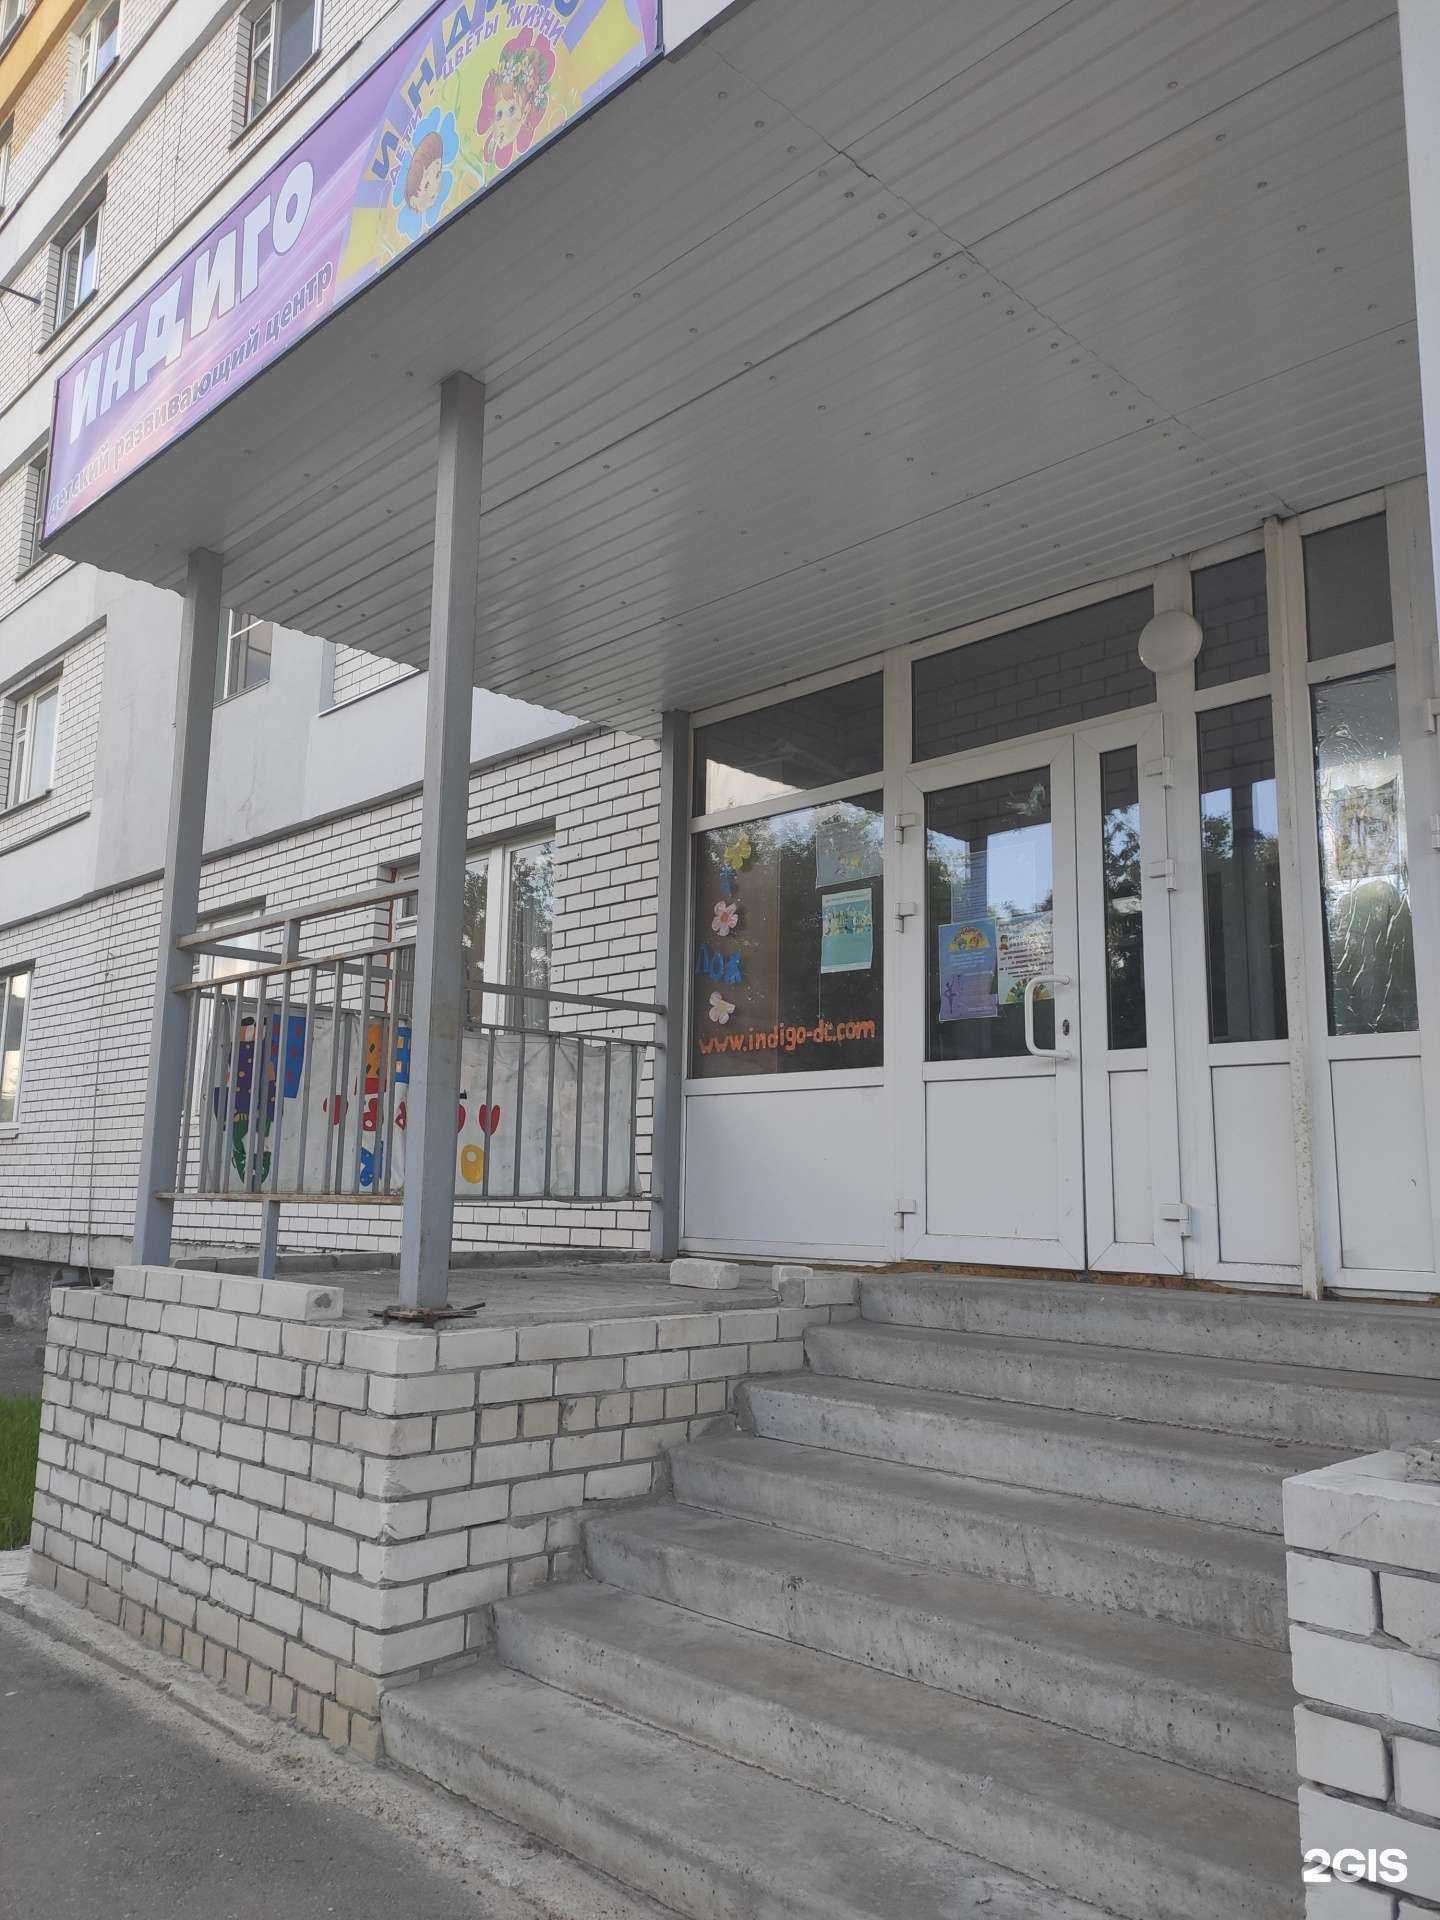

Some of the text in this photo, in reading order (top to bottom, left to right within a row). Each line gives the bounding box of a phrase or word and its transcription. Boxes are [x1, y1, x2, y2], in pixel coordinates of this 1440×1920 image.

[441, 12, 500, 80] ЦВЕТЫ
[505, 3, 567, 50] ЖИЗНИ
[69, 161, 314, 445] ИНДИГО
[112, 324, 260, 474] развивающий
[264, 261, 333, 344] центр
